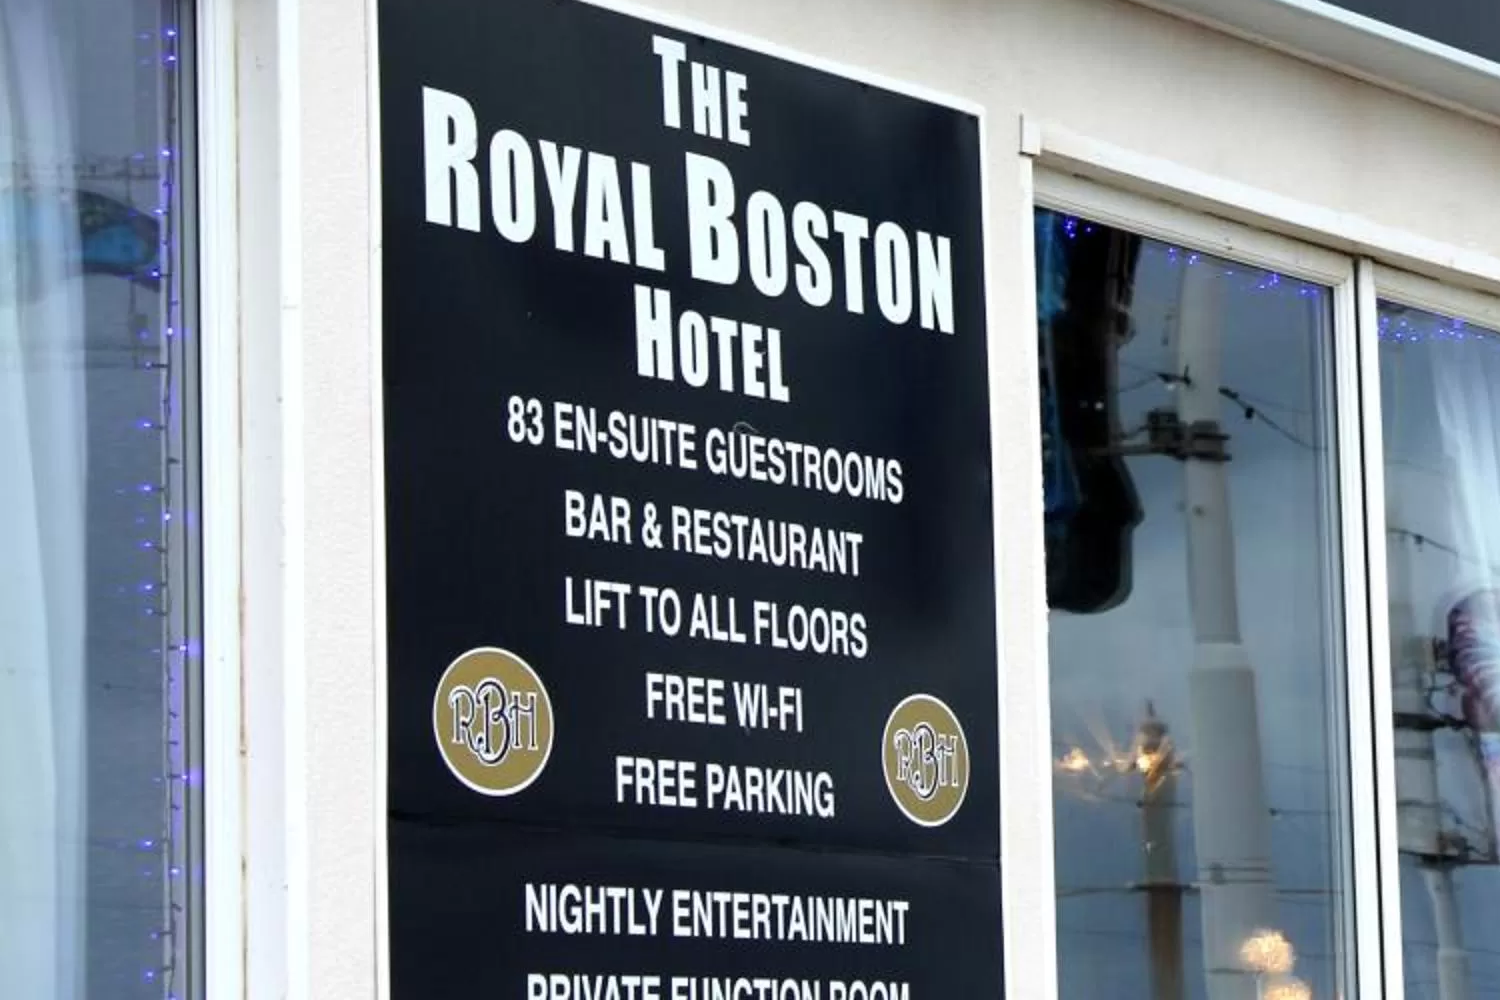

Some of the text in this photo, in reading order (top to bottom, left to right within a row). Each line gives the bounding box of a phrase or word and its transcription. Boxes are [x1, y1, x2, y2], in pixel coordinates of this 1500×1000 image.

[652, 34, 751, 147] THE
[422, 86, 955, 335] ROYAL BOSTON
[634, 284, 790, 403] HOTEL
[507, 395, 904, 504] 83 EN-SUITE GUESTROOMS
[565, 489, 863, 577] BAR & RESTAURANT
[565, 576, 868, 659] LIFT TO ALL FLOORS
[447, 676, 540, 765] RBH
[646, 672, 803, 733] FREE WI-FI
[615, 755, 835, 818] FREE PARKING
[893, 721, 959, 800] RBH
[525, 883, 909, 945] NIGHTLY ENTERTAINMENT
